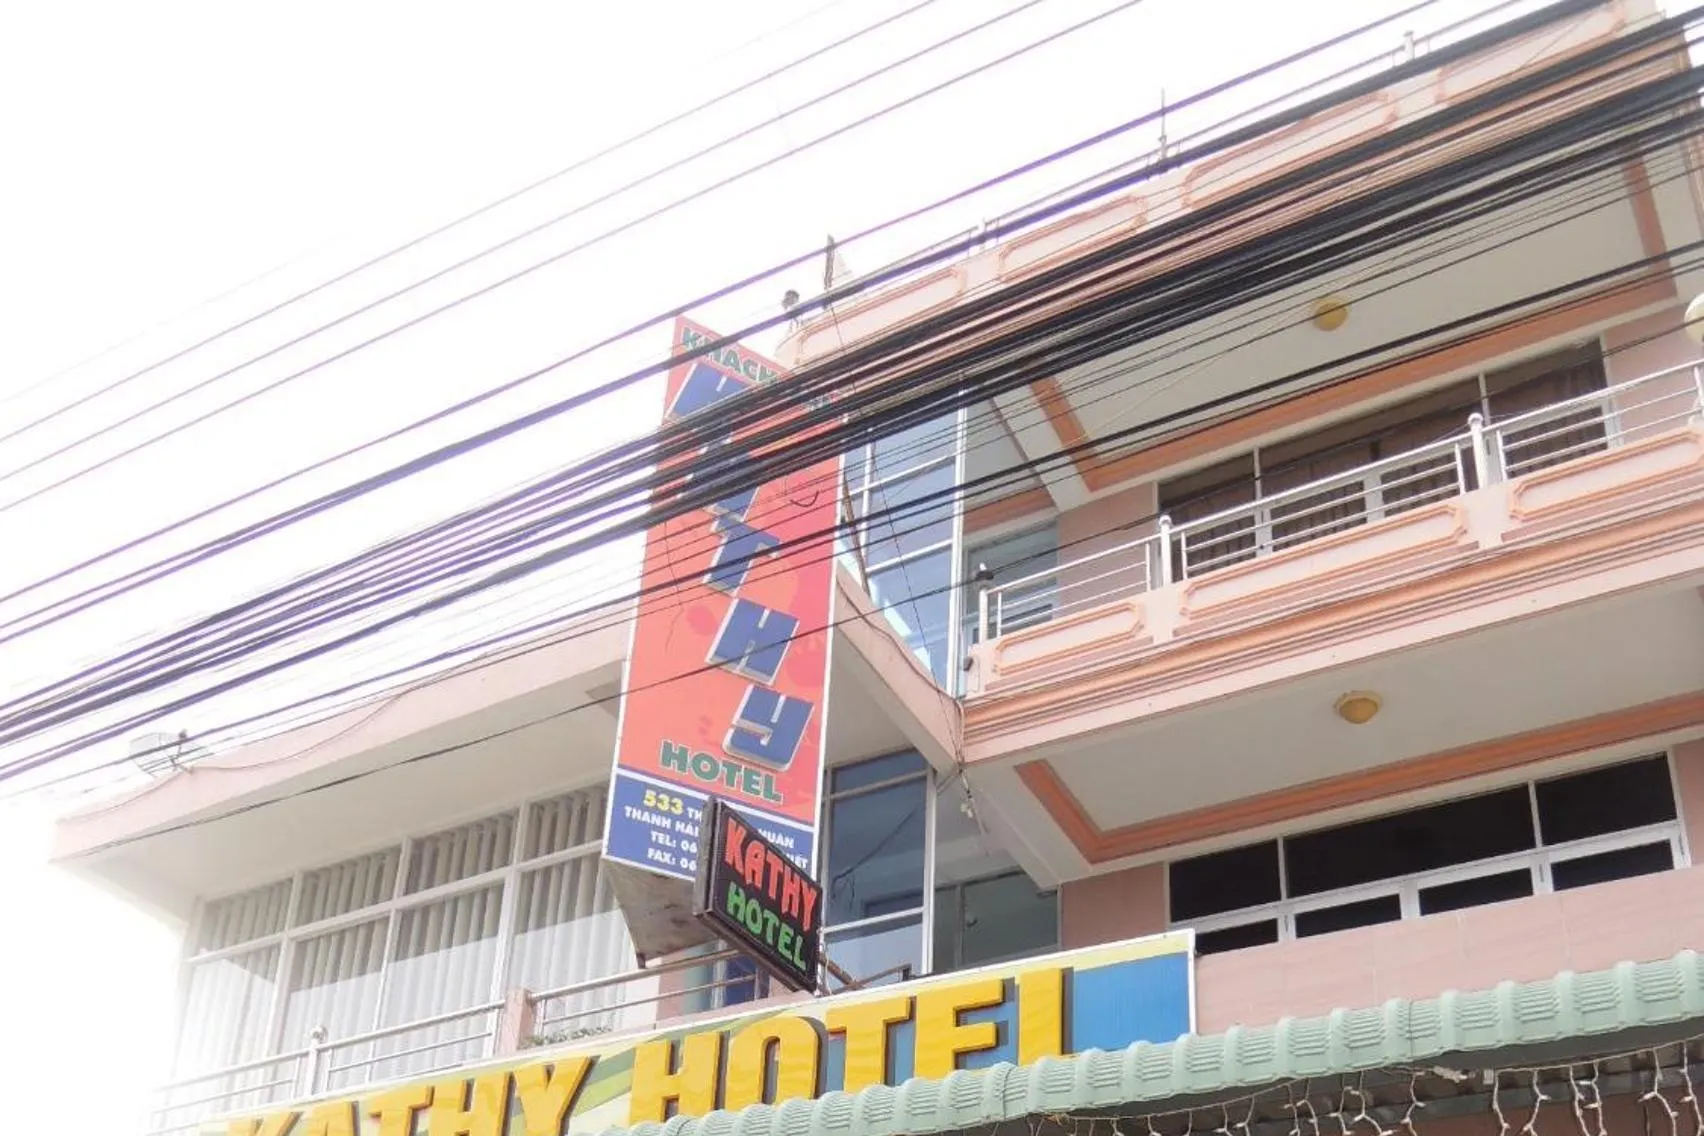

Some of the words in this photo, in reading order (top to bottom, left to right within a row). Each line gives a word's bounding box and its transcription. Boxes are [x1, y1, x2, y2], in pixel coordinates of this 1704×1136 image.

[661, 739, 782, 802] HOTEL
[624, 805, 672, 830] THANH
[643, 789, 685, 816] 533
[647, 847, 677, 866] FAX:
[679, 857, 698, 872] 06
[650, 830, 677, 849] TEL:
[680, 839, 698, 854] 06
[725, 817, 817, 931] KATHY
[727, 882, 806, 969] HOTEL
[629, 967, 1075, 1125] HOTEL
